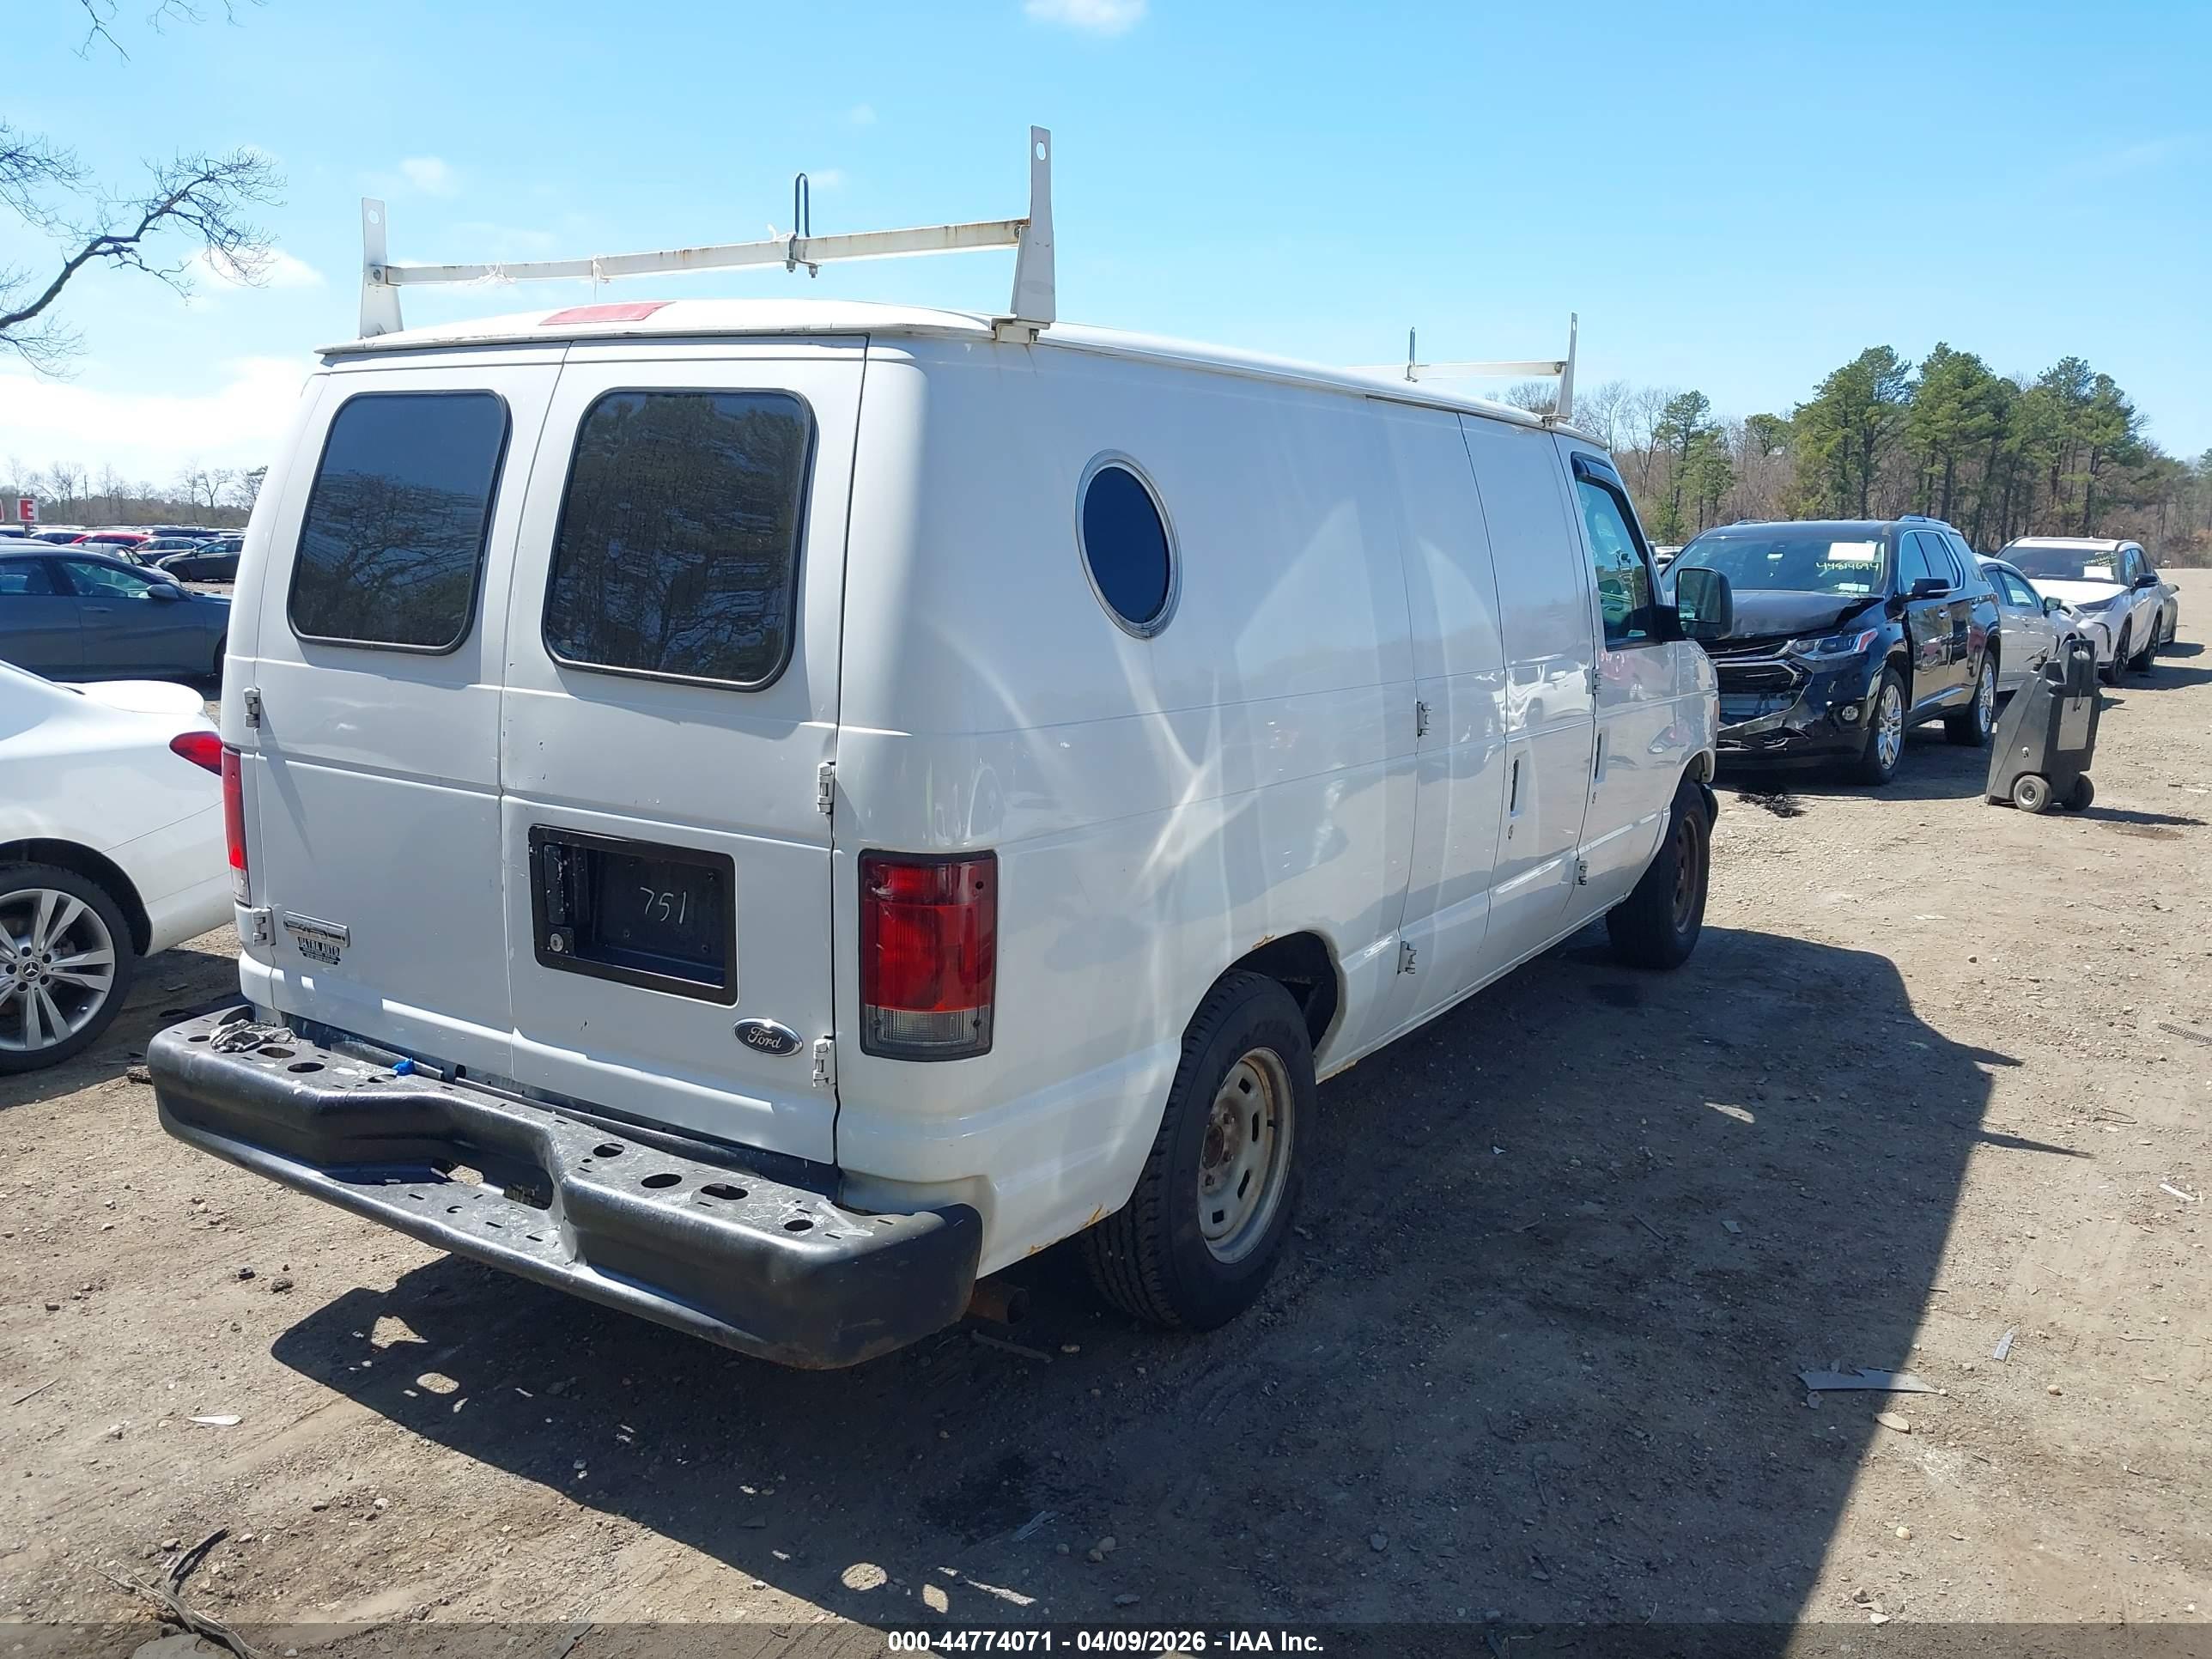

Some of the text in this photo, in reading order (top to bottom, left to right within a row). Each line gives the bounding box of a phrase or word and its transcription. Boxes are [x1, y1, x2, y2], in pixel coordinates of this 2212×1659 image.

[20, 499, 35, 520] E
[1815, 562, 1879, 573] 44814694
[640, 886, 686, 924] 751
[747, 1026, 782, 1048] Ford
